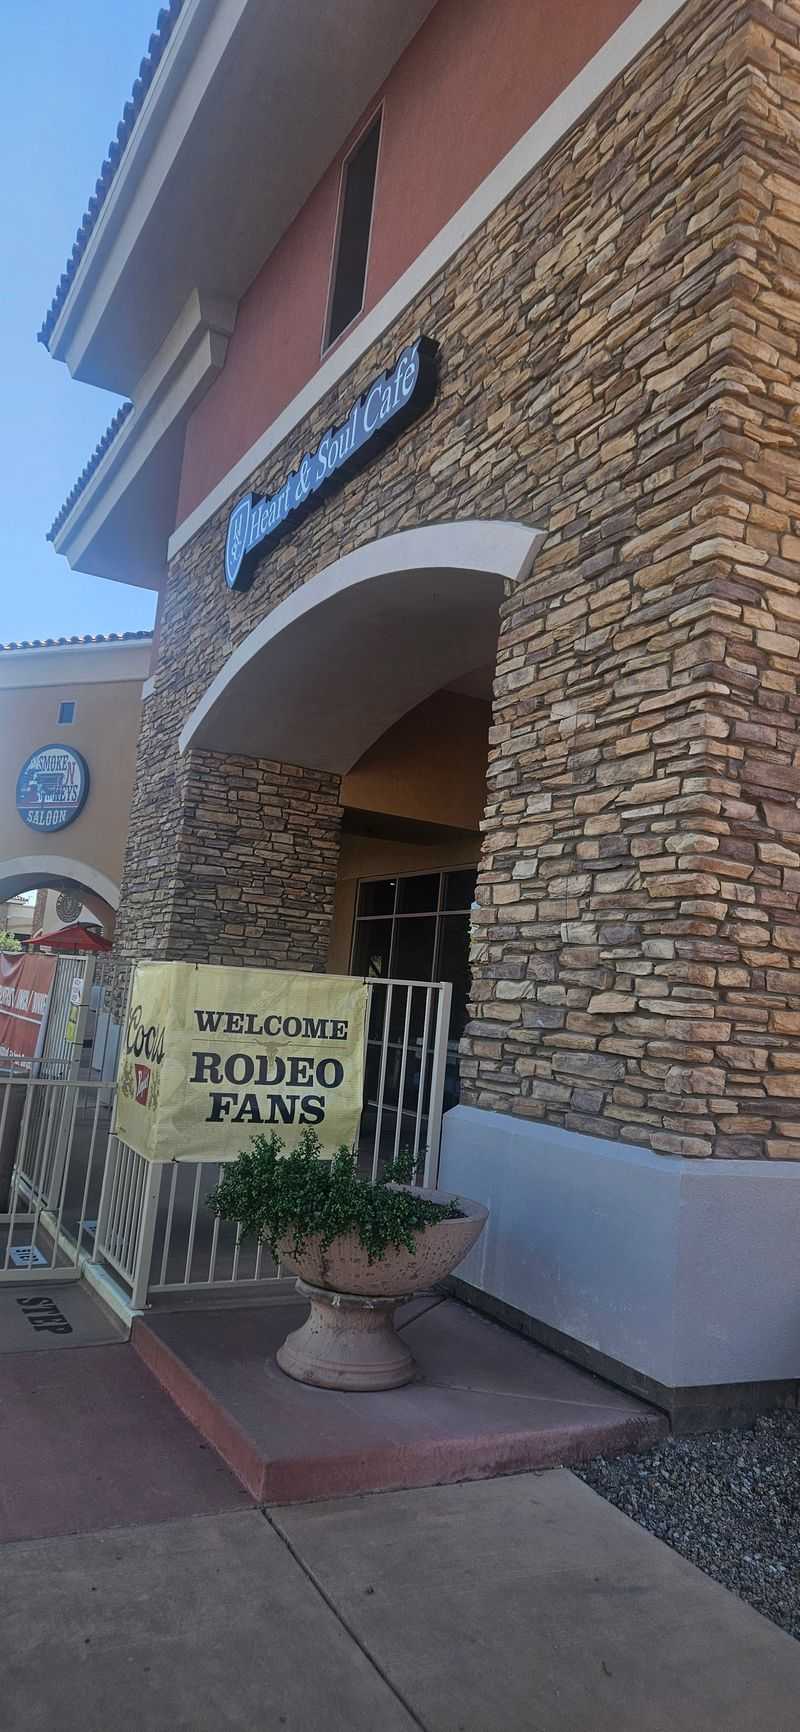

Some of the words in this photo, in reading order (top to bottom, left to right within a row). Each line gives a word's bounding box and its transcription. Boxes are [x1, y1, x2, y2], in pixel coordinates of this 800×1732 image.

[249, 485, 291, 545] Heart
[295, 460, 312, 501] &
[316, 409, 357, 479] Soul
[363, 344, 418, 432] Café
[39, 754, 69, 772] SMOKE
[66, 760, 76, 785] N
[27, 810, 67, 826] SALOON
[193, 1009, 349, 1040] WELCOME
[190, 1051, 345, 1089] RODEO
[205, 1092, 326, 1125] FANS
[16, 1297, 73, 1334] STEP
